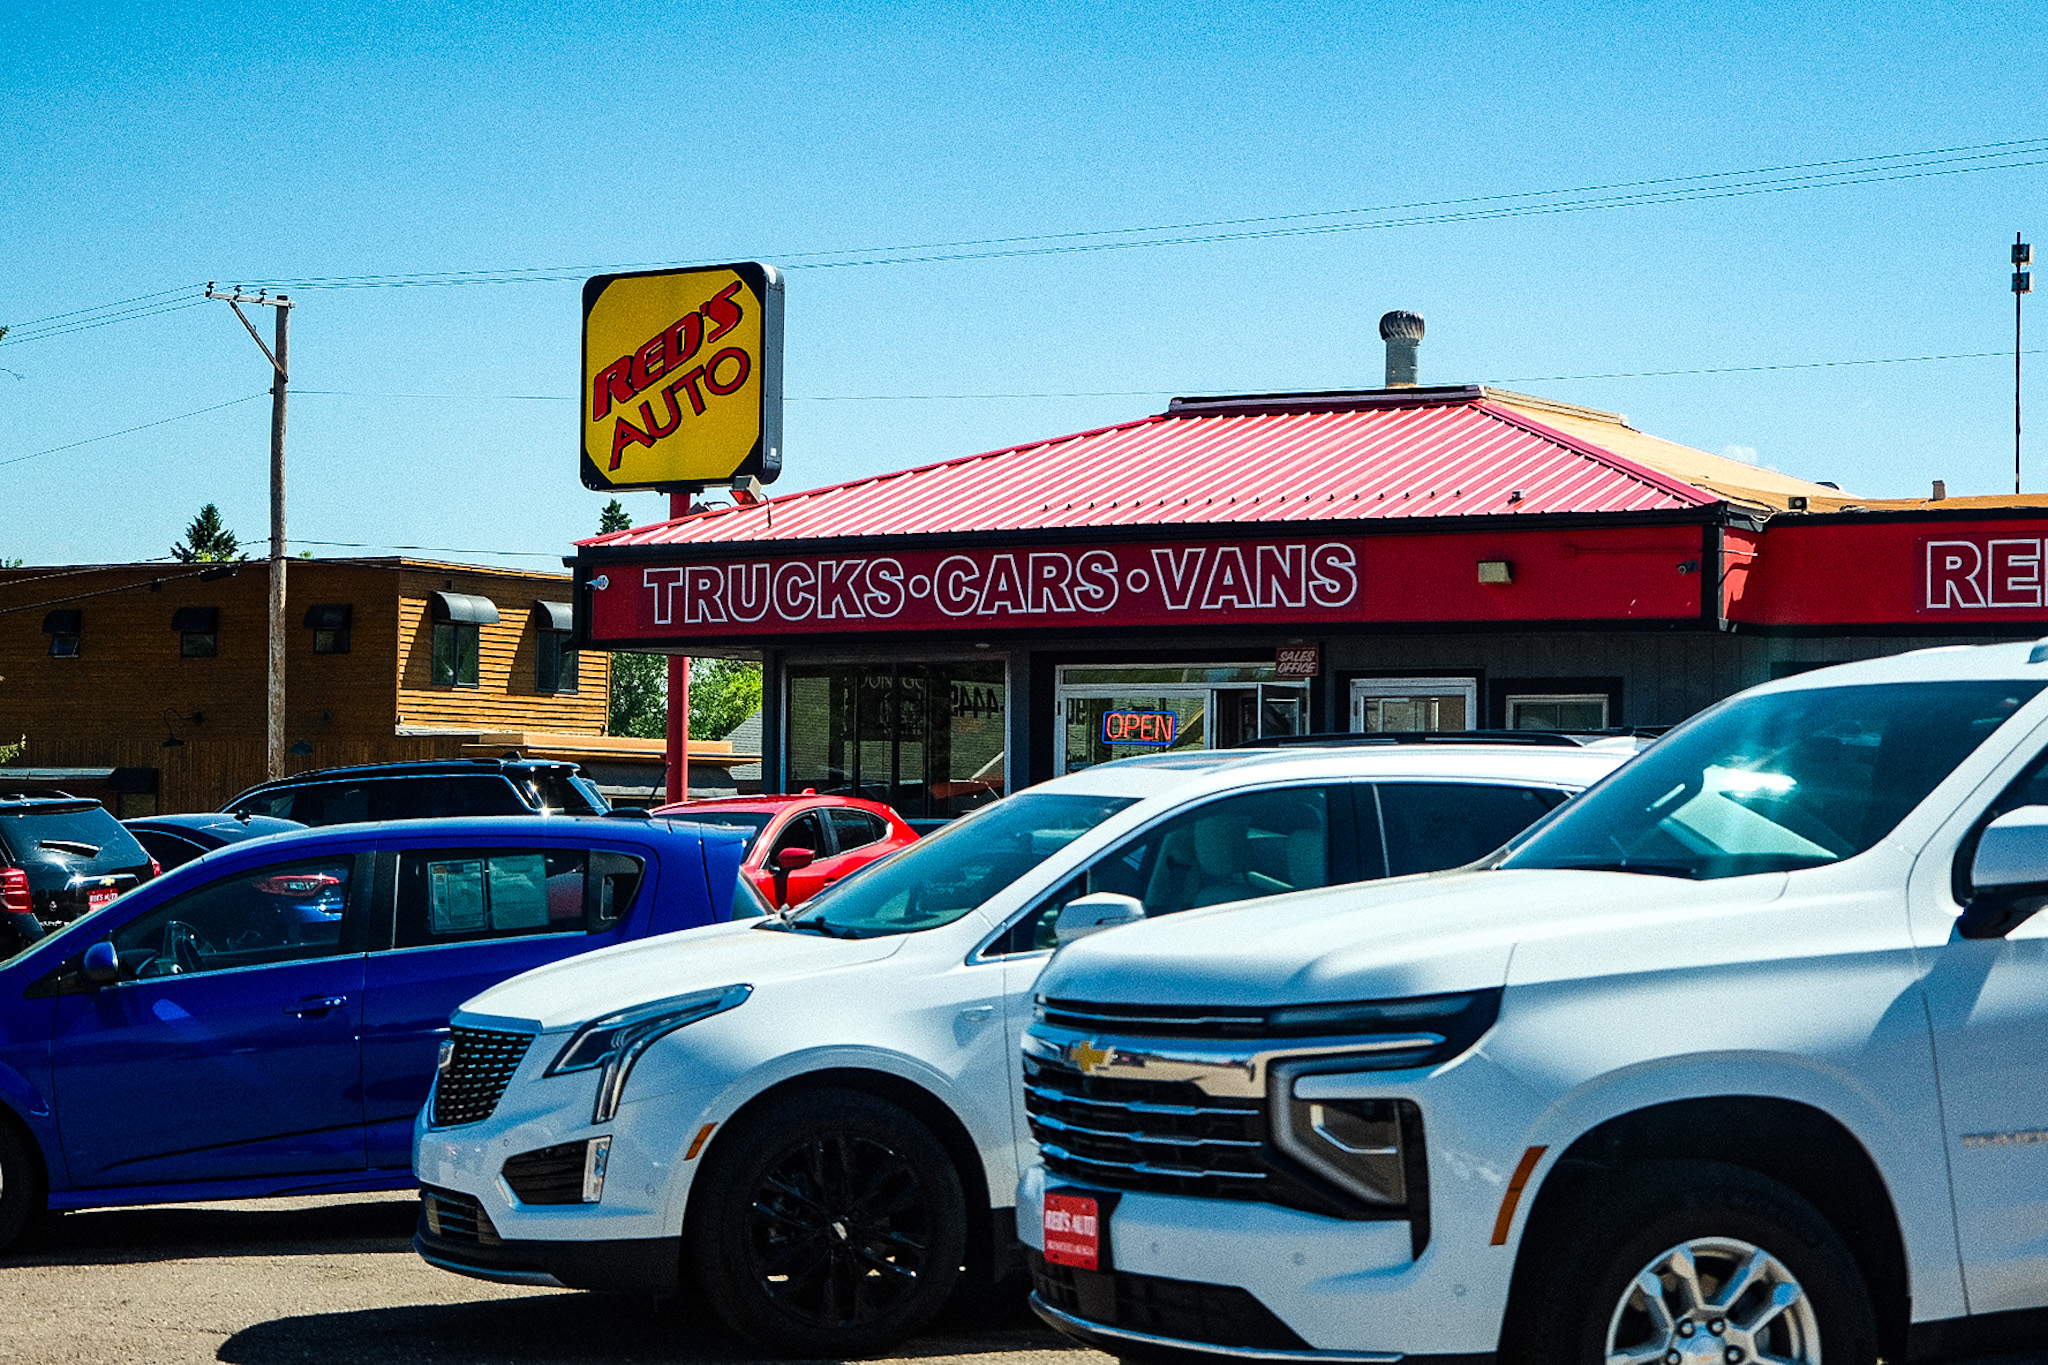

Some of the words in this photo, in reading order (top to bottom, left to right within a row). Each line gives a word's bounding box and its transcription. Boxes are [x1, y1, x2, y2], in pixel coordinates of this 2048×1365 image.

[592, 280, 743, 421] RED'S
[609, 347, 751, 472] AUTO
[643, 557, 906, 624] TRUCKS
[933, 550, 1119, 616] CARS
[1150, 542, 1358, 610] VANS
[1927, 538, 2048, 608] RE
[1277, 662, 1316, 674] OFFICE
[1279, 651, 1315, 662] SALES
[1106, 713, 1174, 741] OPEN
